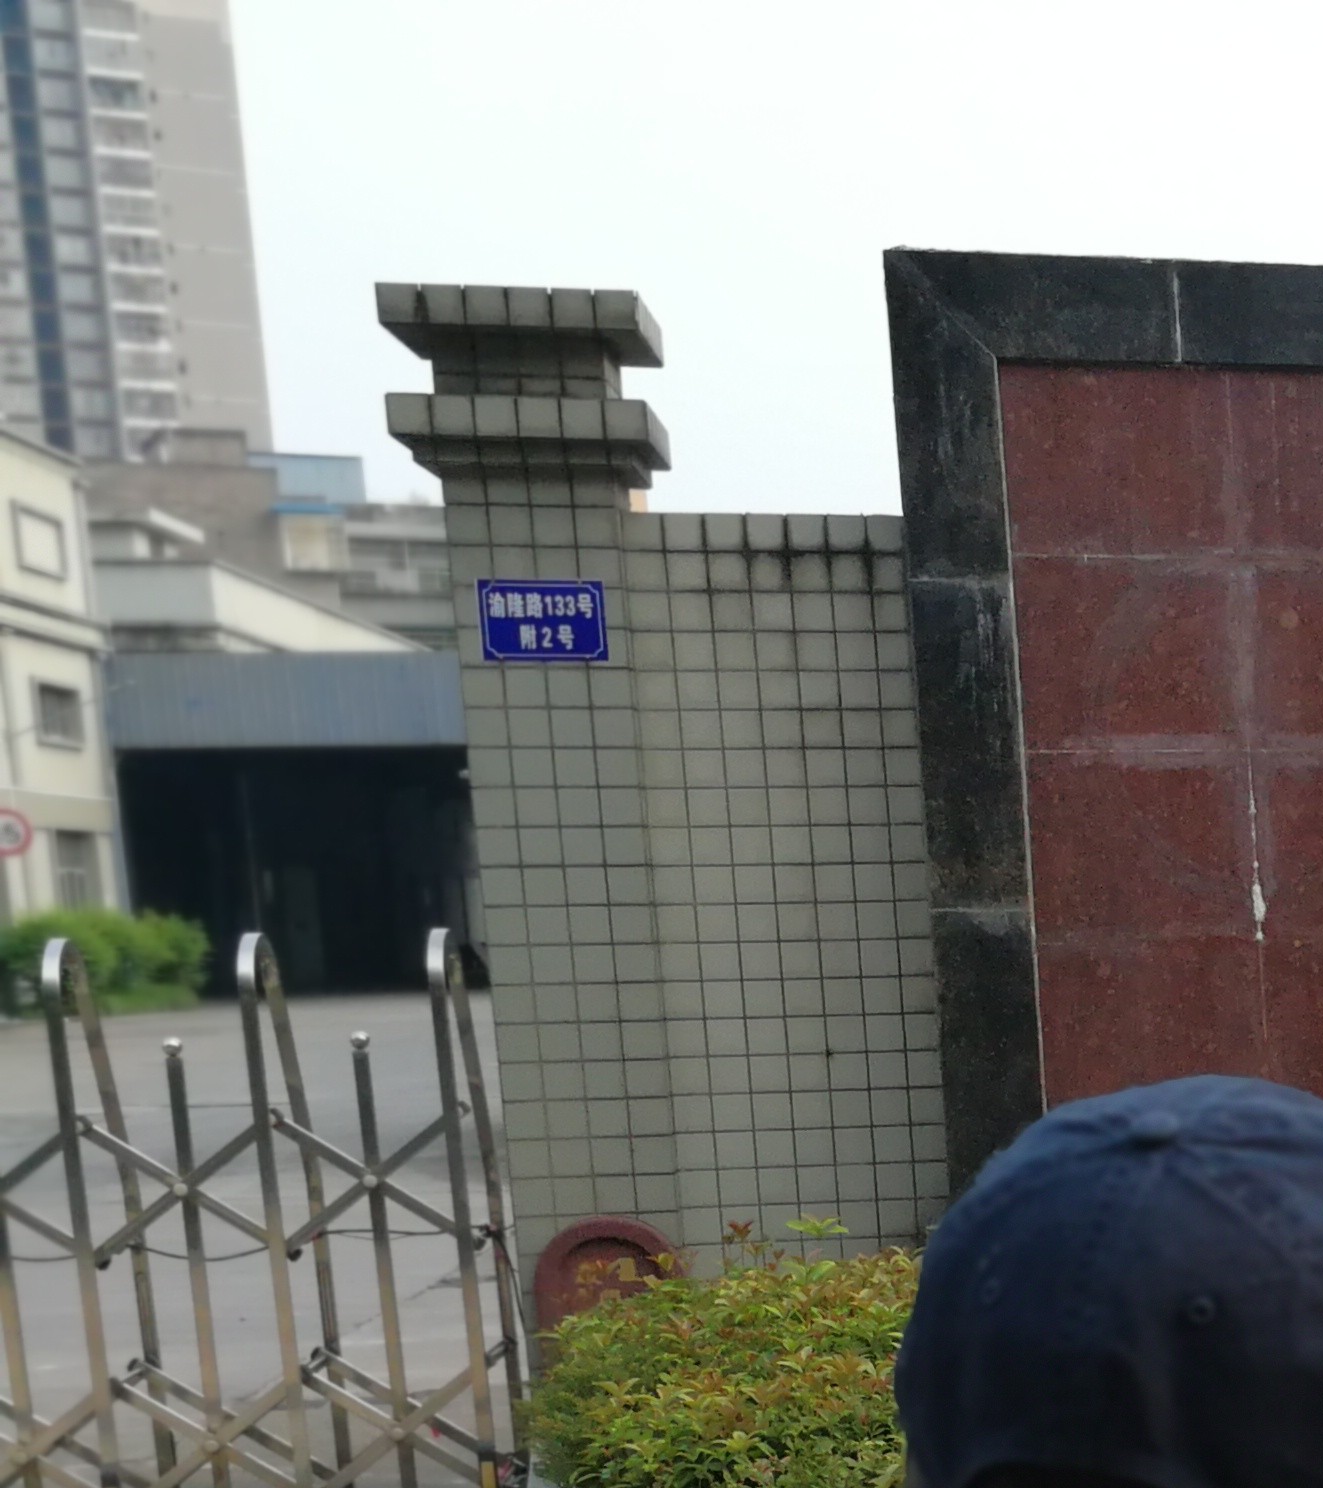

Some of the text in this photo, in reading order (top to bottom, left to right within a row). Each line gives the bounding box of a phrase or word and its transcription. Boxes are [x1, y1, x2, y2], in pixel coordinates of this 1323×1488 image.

[488, 592, 594, 619] 渝隆路133号
[519, 624, 575, 650] 附2号
